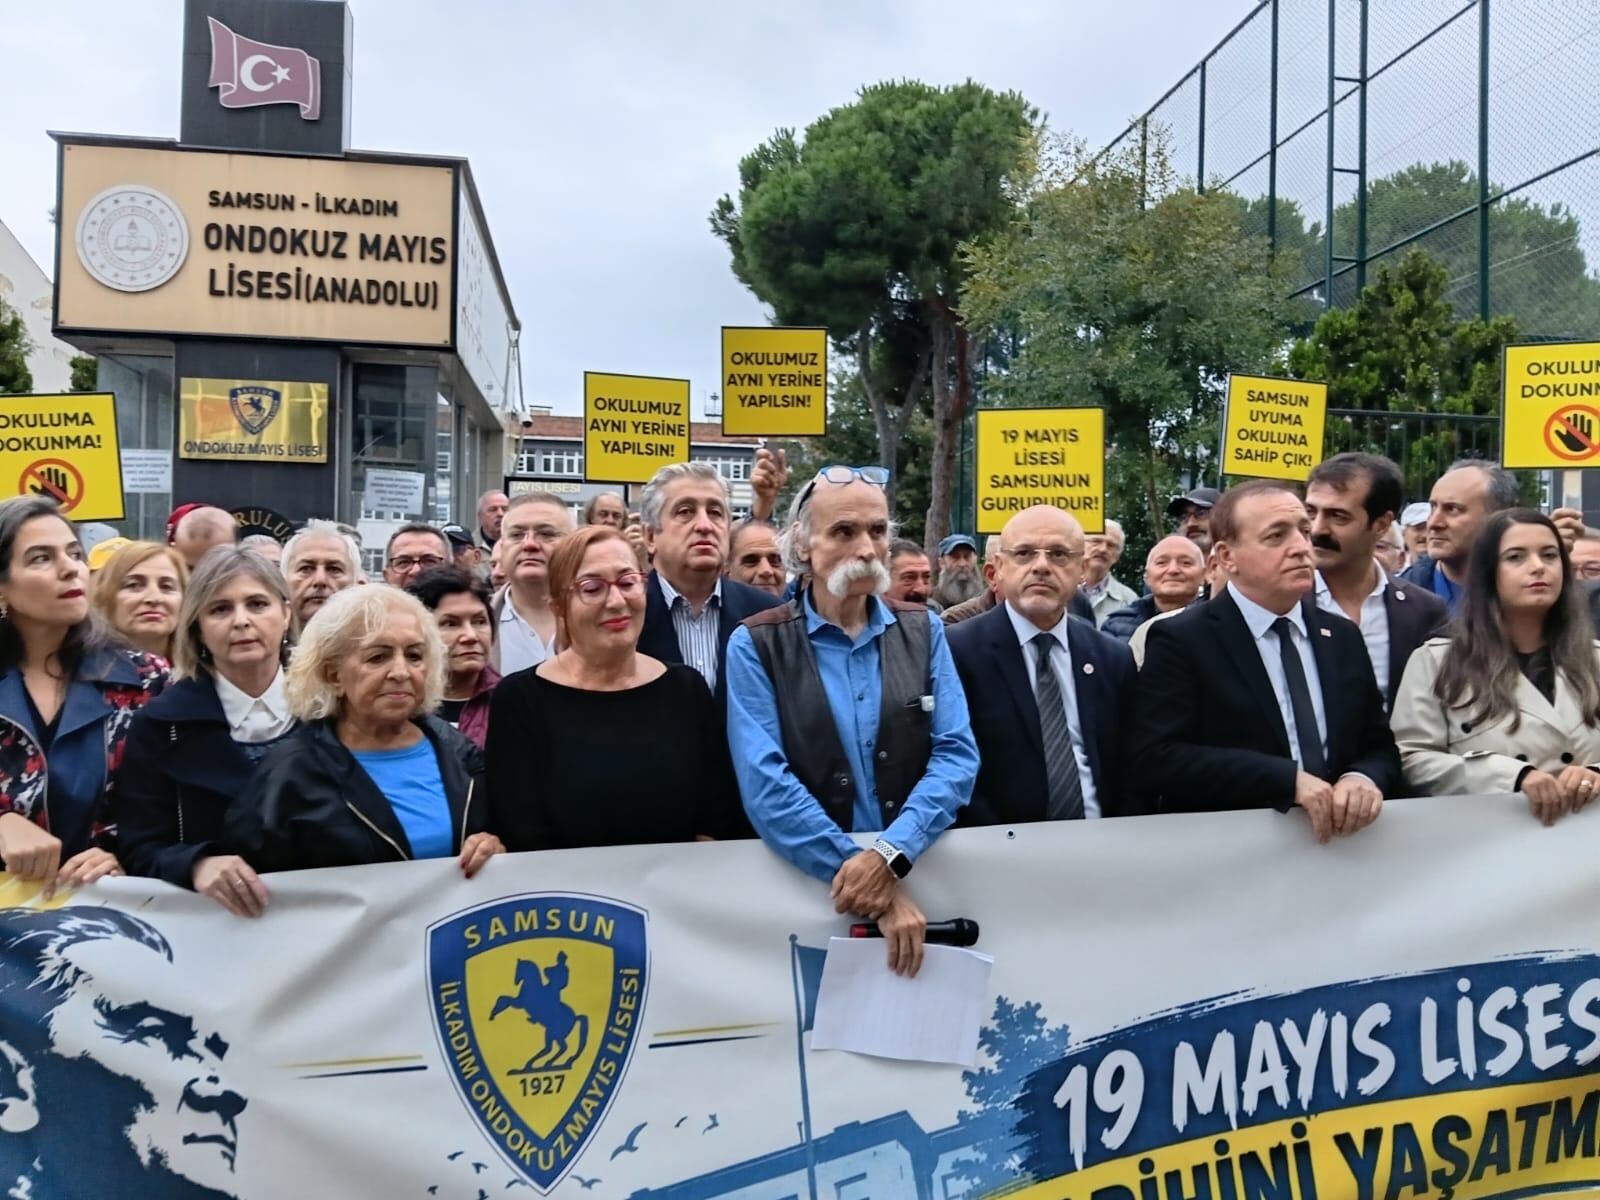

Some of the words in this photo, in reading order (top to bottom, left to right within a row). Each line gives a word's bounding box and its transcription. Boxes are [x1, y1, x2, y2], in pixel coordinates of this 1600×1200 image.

[209, 190, 295, 211] SAMSUN
[316, 192, 398, 217] İLKADIM
[204, 223, 348, 259] ONDOKUZ
[359, 233, 447, 264] MAYIS
[731, 352, 818, 366] OKULUMUZ
[727, 373, 763, 387] AYNI
[768, 370, 822, 387] YERİNE
[594, 397, 682, 416] OKULUMUZ
[738, 394, 811, 408] YAPILSIN!
[1247, 390, 1309, 407] SAMSUN
[0, 412, 95, 429] OKULUMA
[590, 418, 626, 433] AYNI
[632, 420, 686, 437] YERİNE
[1250, 410, 1303, 427] UYUMA
[1001, 430, 1019, 443] 19
[1024, 429, 1079, 443] MAYIS
[1237, 428, 1309, 447] OKULUNA
[184, 440, 246, 455] ONDOKUZ
[249, 443, 286, 456] MAYIS
[287, 443, 323, 457] LİSESİ
[601, 440, 675, 457] YAPILSIN!
[1014, 448, 1066, 466] LİSESİ
[1234, 447, 1279, 463] SAHİP
[1282, 453, 1312, 468] ÇIK!
[990, 474, 1090, 488] SAMSUNUN
[464, 908, 616, 949] SAMSUN
[606, 967, 641, 1055] LİSESİ
[439, 980, 481, 1081] İLKADIM
[519, 1074, 566, 1097] 1927
[1052, 1049, 1145, 1170] 19
[1172, 1002, 1396, 1133] MAYIS
[1333, 1089, 1600, 1200] YAŞATM
